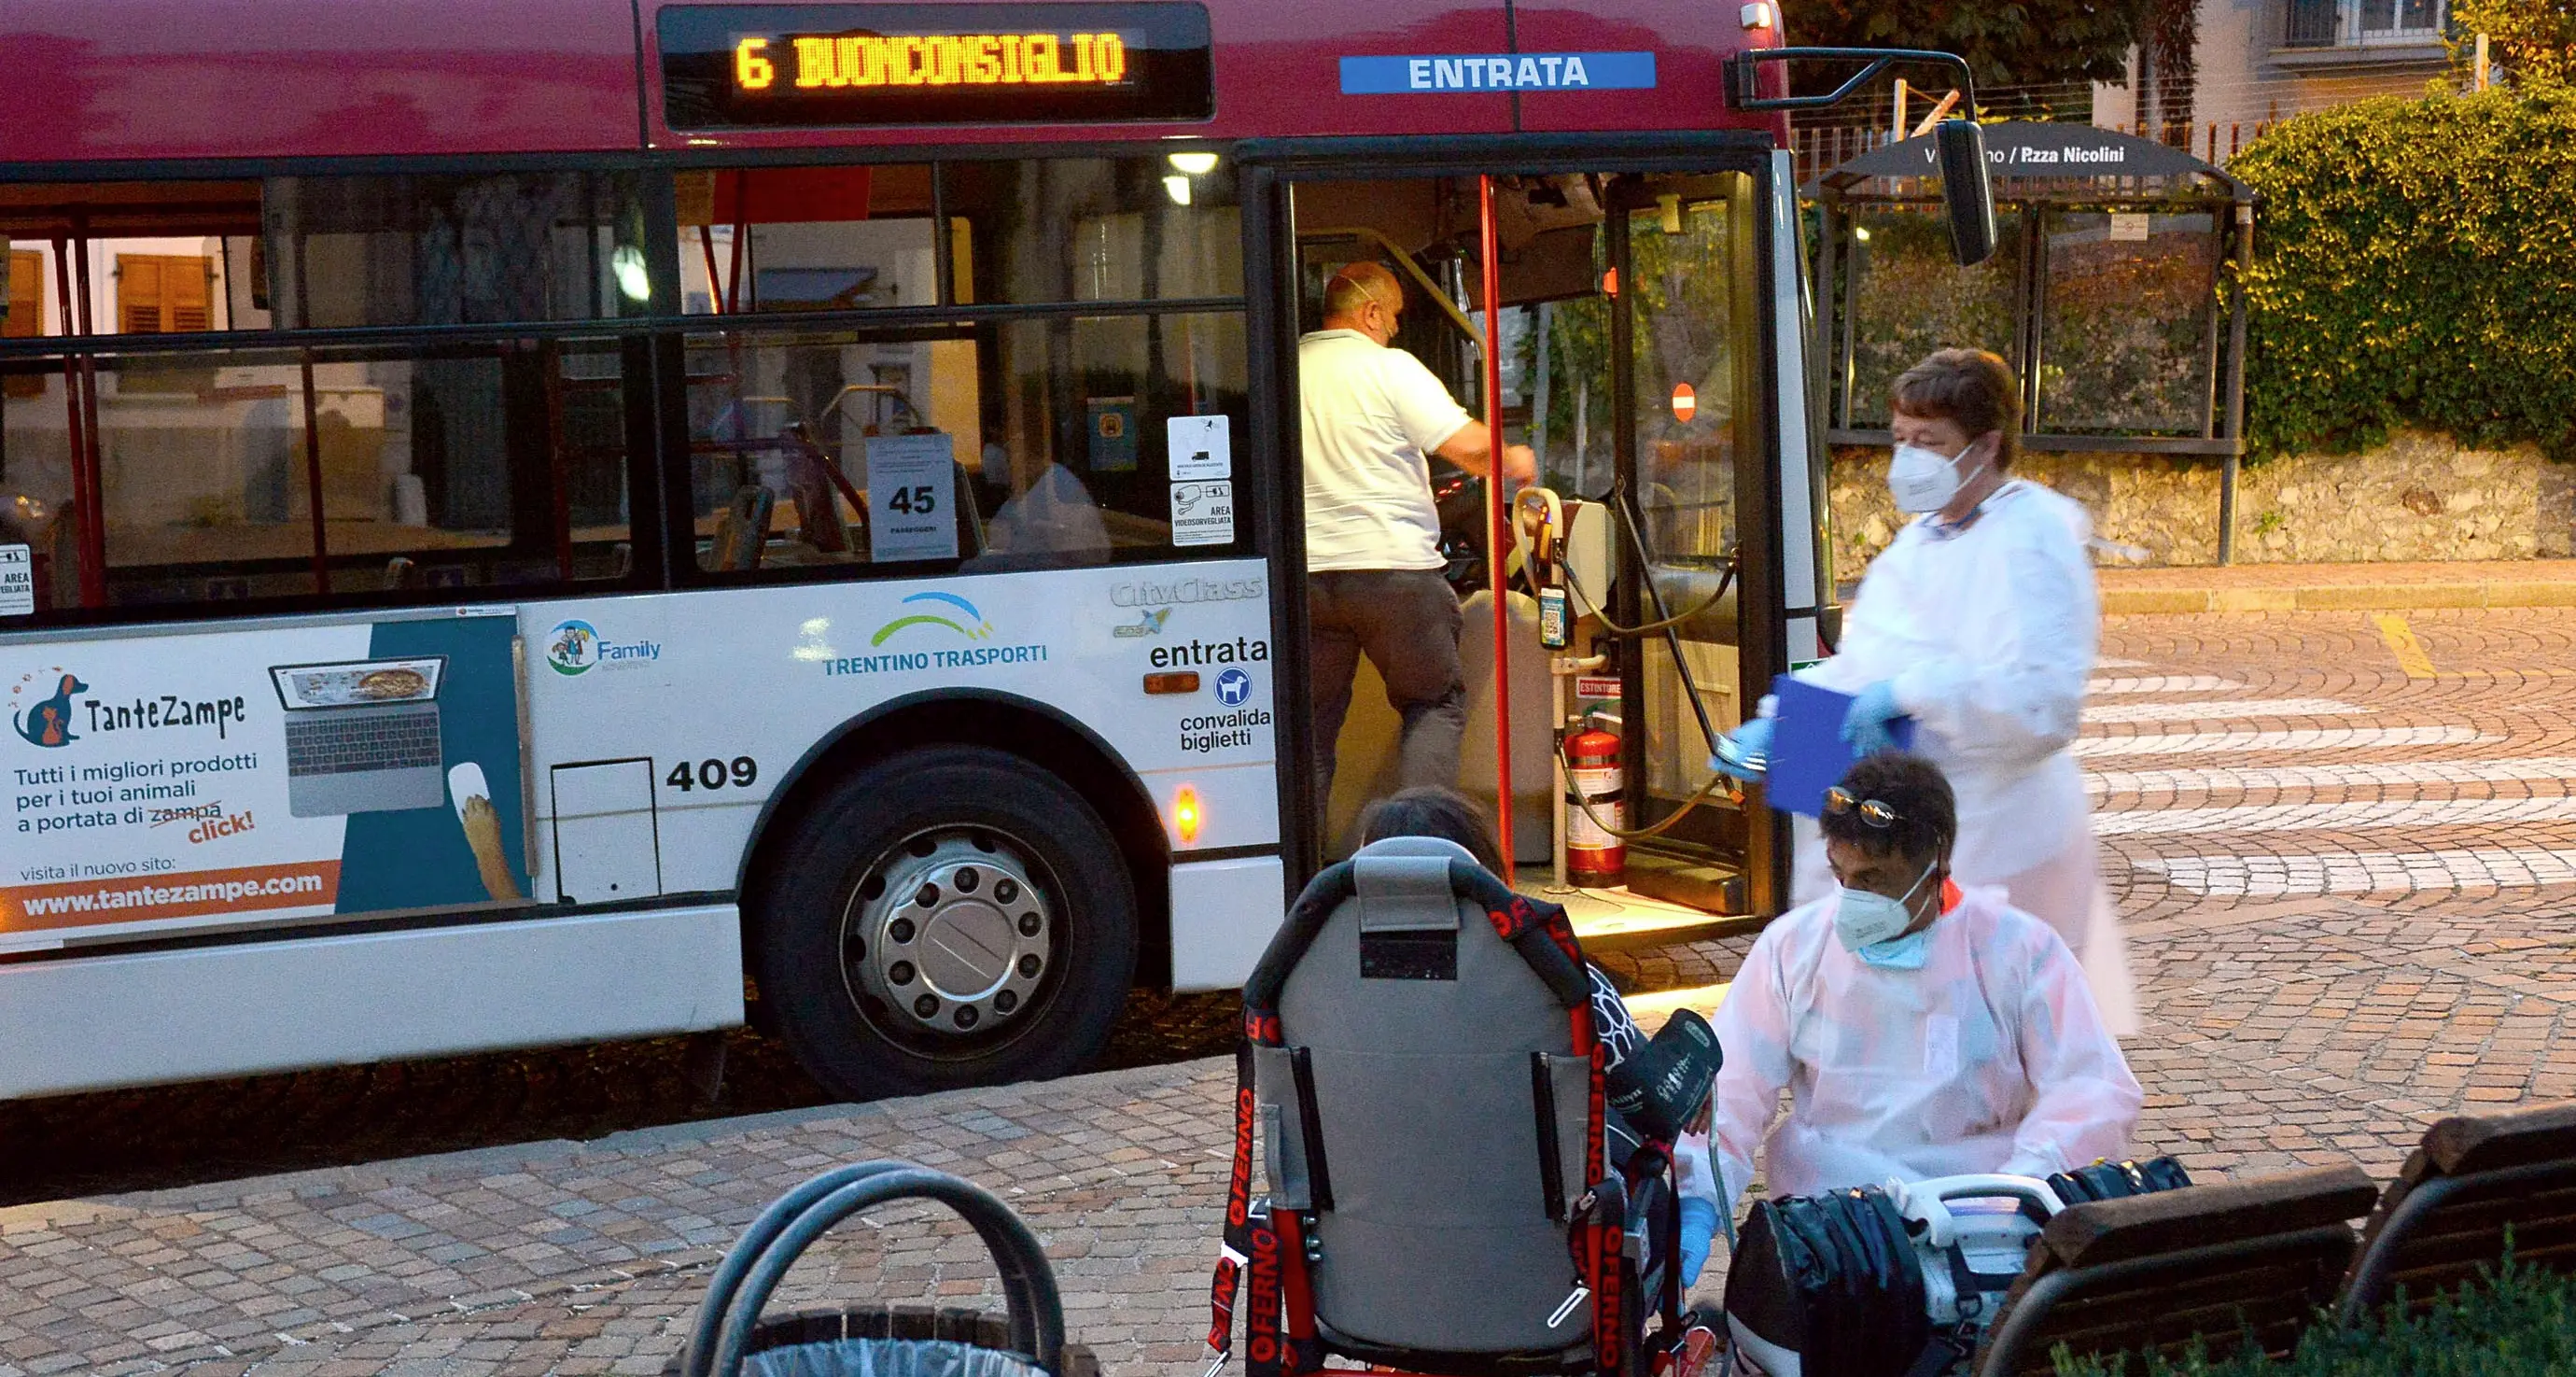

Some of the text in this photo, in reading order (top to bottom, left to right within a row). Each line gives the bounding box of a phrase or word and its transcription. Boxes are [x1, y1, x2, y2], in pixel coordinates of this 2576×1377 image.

[736, 33, 1126, 88] 6 BUONCONSIGLIO
[1408, 56, 1589, 89] ENTRATA
[2021, 147, 2058, 162] P.zza
[2063, 147, 2124, 162] Nicolini
[889, 485, 935, 514] 45
[1211, 505, 1231, 516] AREA
[1174, 516, 1232, 527] VIDEOSORVEGLIATA
[5, 572, 30, 583] AREA
[1111, 577, 1264, 608] CityClass
[597, 640, 662, 661] Family
[822, 644, 1048, 676] TRENTINO TRASPORTI
[1150, 637, 1269, 668] entrata
[1579, 682, 1621, 694] ESTINTORE
[85, 695, 245, 739] TanteZampe
[1180, 709, 1271, 732] convalida
[1181, 728, 1252, 753] biglietti
[14, 752, 258, 786] Tutti i migliori prodotti
[665, 755, 758, 793] 409
[16, 780, 196, 812] per i tuoi animali
[18, 802, 222, 834] a portata di zampa
[188, 810, 255, 845] click!
[21, 856, 175, 881] visita il nuovo sito:
[22, 873, 322, 916] www.tantezampe.com
[1232, 1088, 1253, 1201] FERNO
[1252, 1228, 1278, 1334] FERNO
[1602, 1256, 1620, 1368] FERNO
